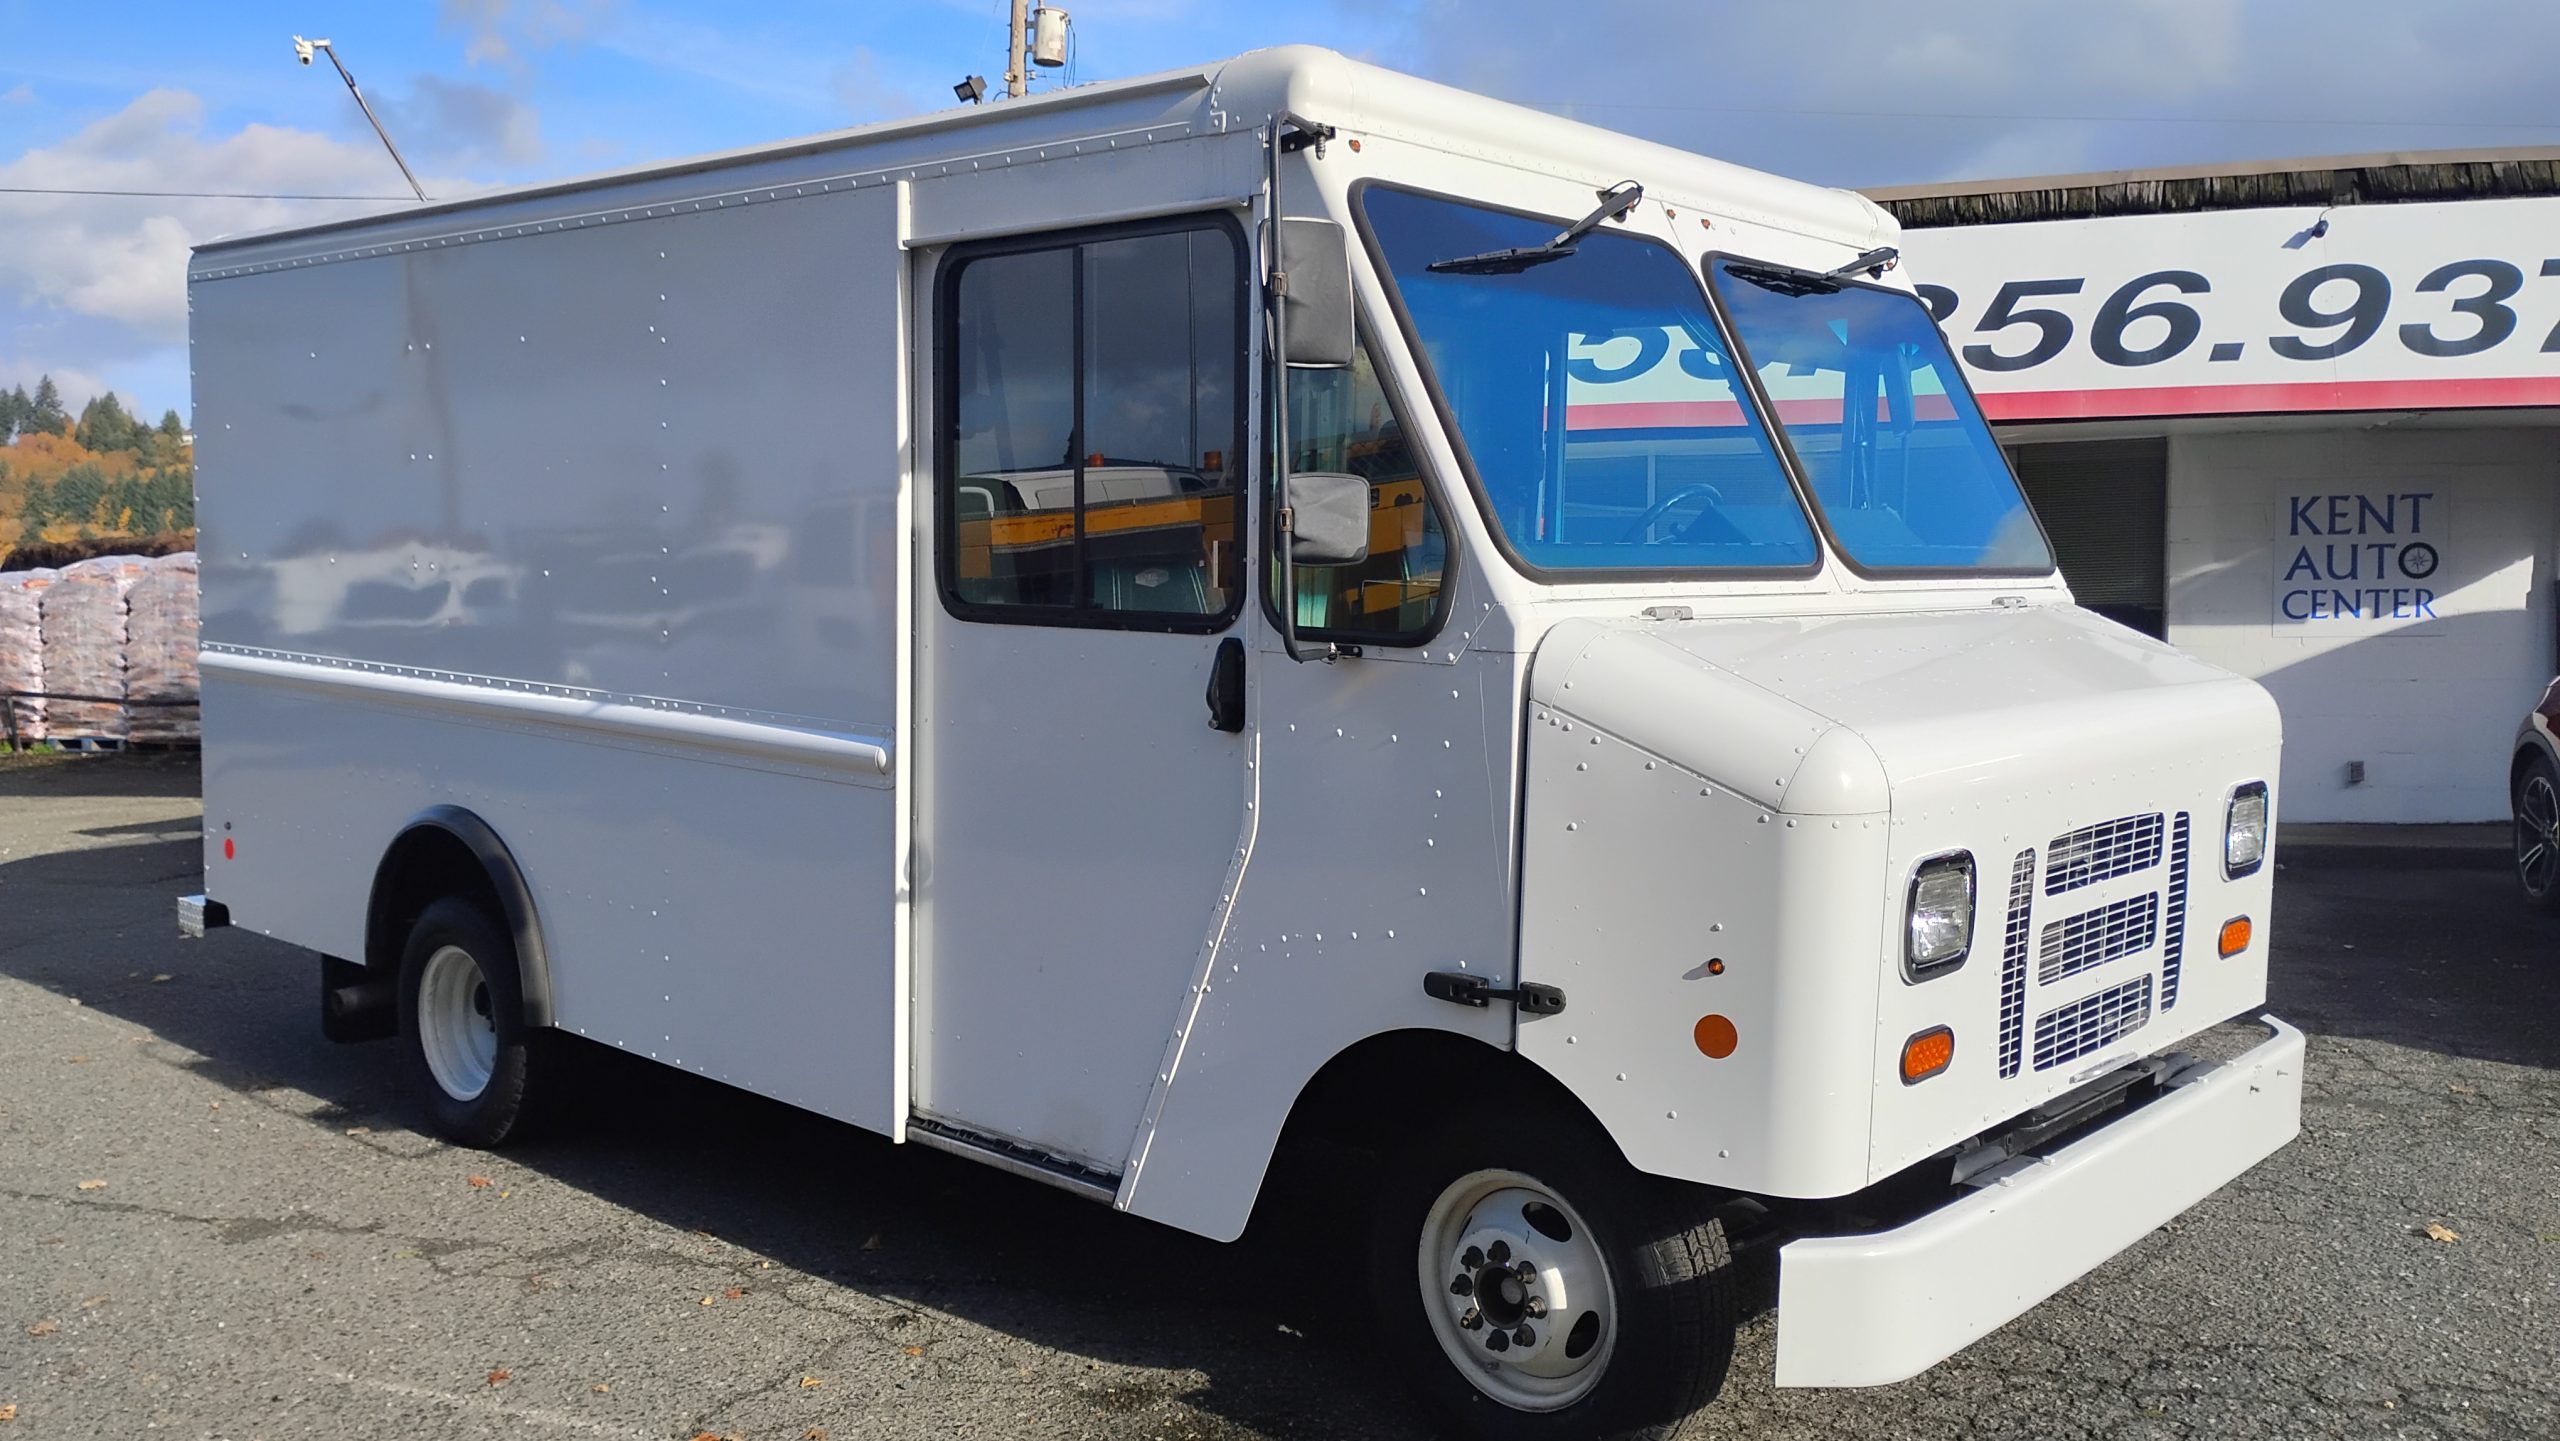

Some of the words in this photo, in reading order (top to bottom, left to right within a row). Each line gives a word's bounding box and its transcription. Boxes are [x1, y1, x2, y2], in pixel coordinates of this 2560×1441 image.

[2290, 493, 2434, 536] KENT
[2283, 541, 2439, 581] AUTO
[2282, 588, 2437, 620] CENTER
